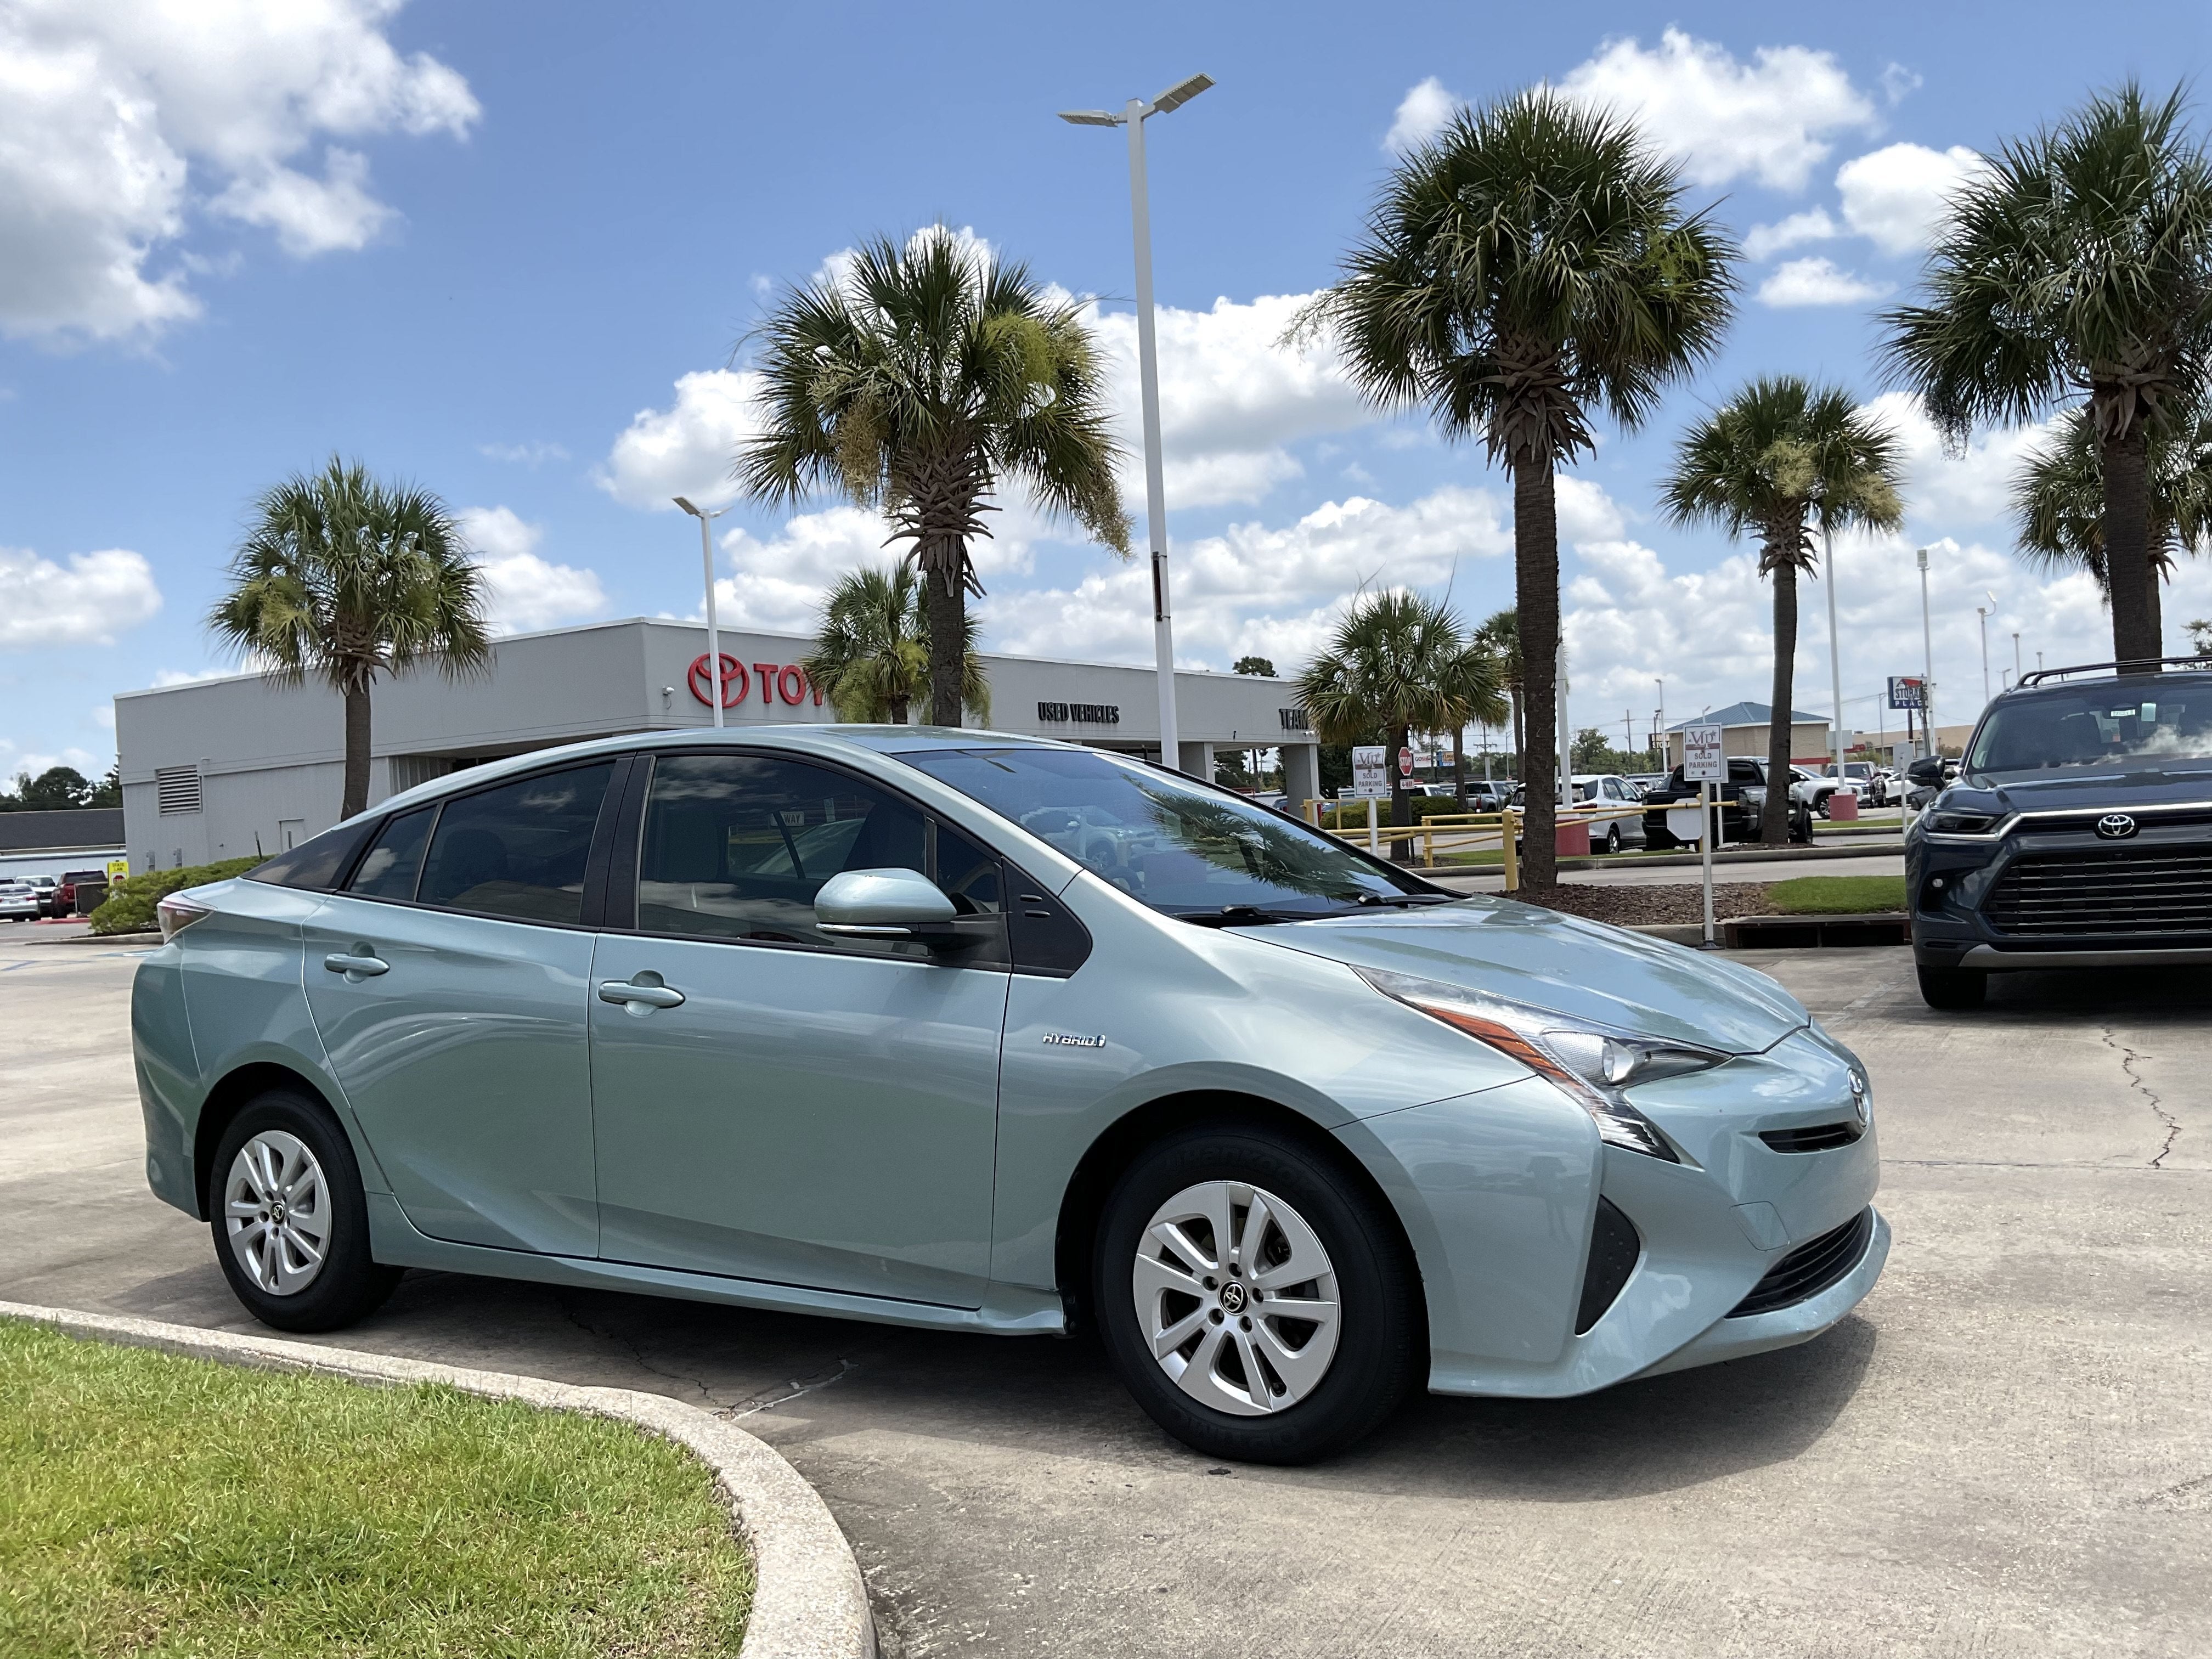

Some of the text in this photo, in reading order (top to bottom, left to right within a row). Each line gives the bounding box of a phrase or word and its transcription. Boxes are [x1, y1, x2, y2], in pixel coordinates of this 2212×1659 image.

[1038, 702, 1120, 723] USED VEHICLES
[1400, 757, 1411, 766] STOP
[1043, 1032, 1096, 1047] HYBRID
